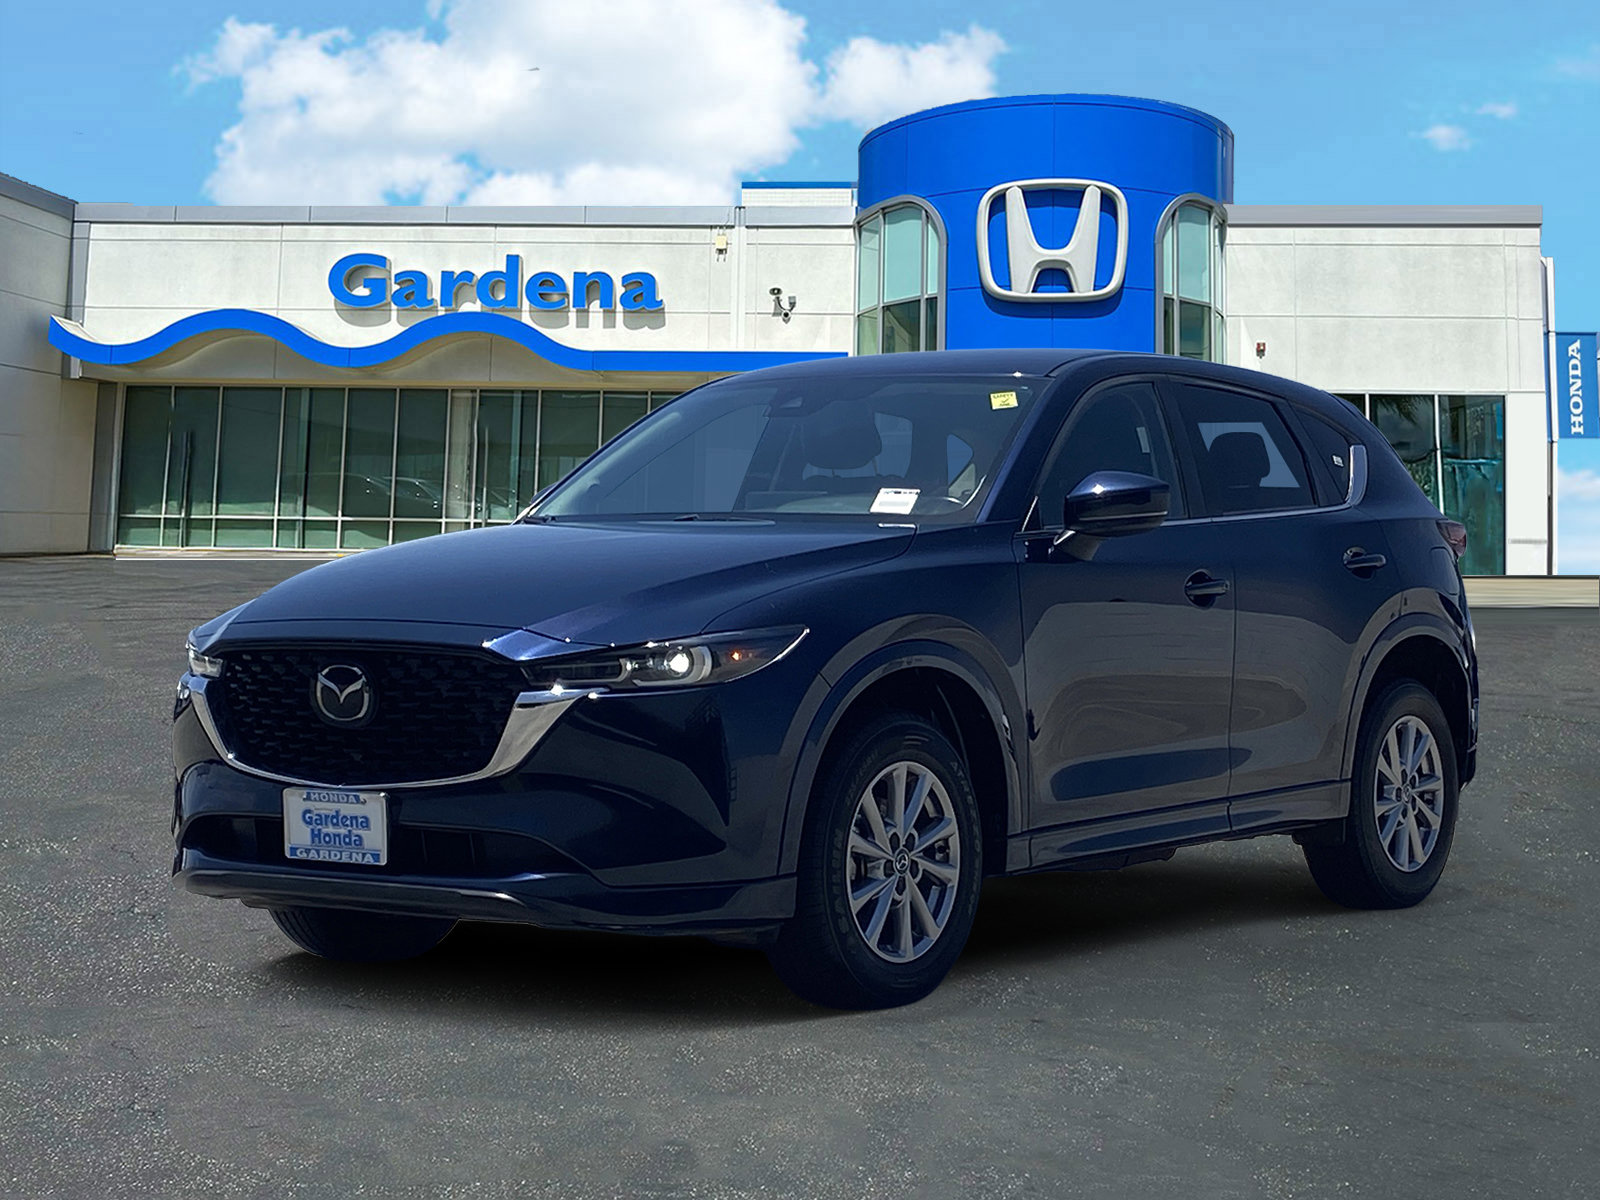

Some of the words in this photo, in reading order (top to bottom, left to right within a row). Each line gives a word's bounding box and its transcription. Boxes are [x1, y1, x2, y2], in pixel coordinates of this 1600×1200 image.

[328, 252, 664, 311] Gardena
[1568, 338, 1584, 435] HONDA
[310, 791, 357, 804] HONDA
[302, 808, 370, 829] Gardena
[310, 828, 364, 847] Honda
[296, 848, 375, 863] GARDENA
